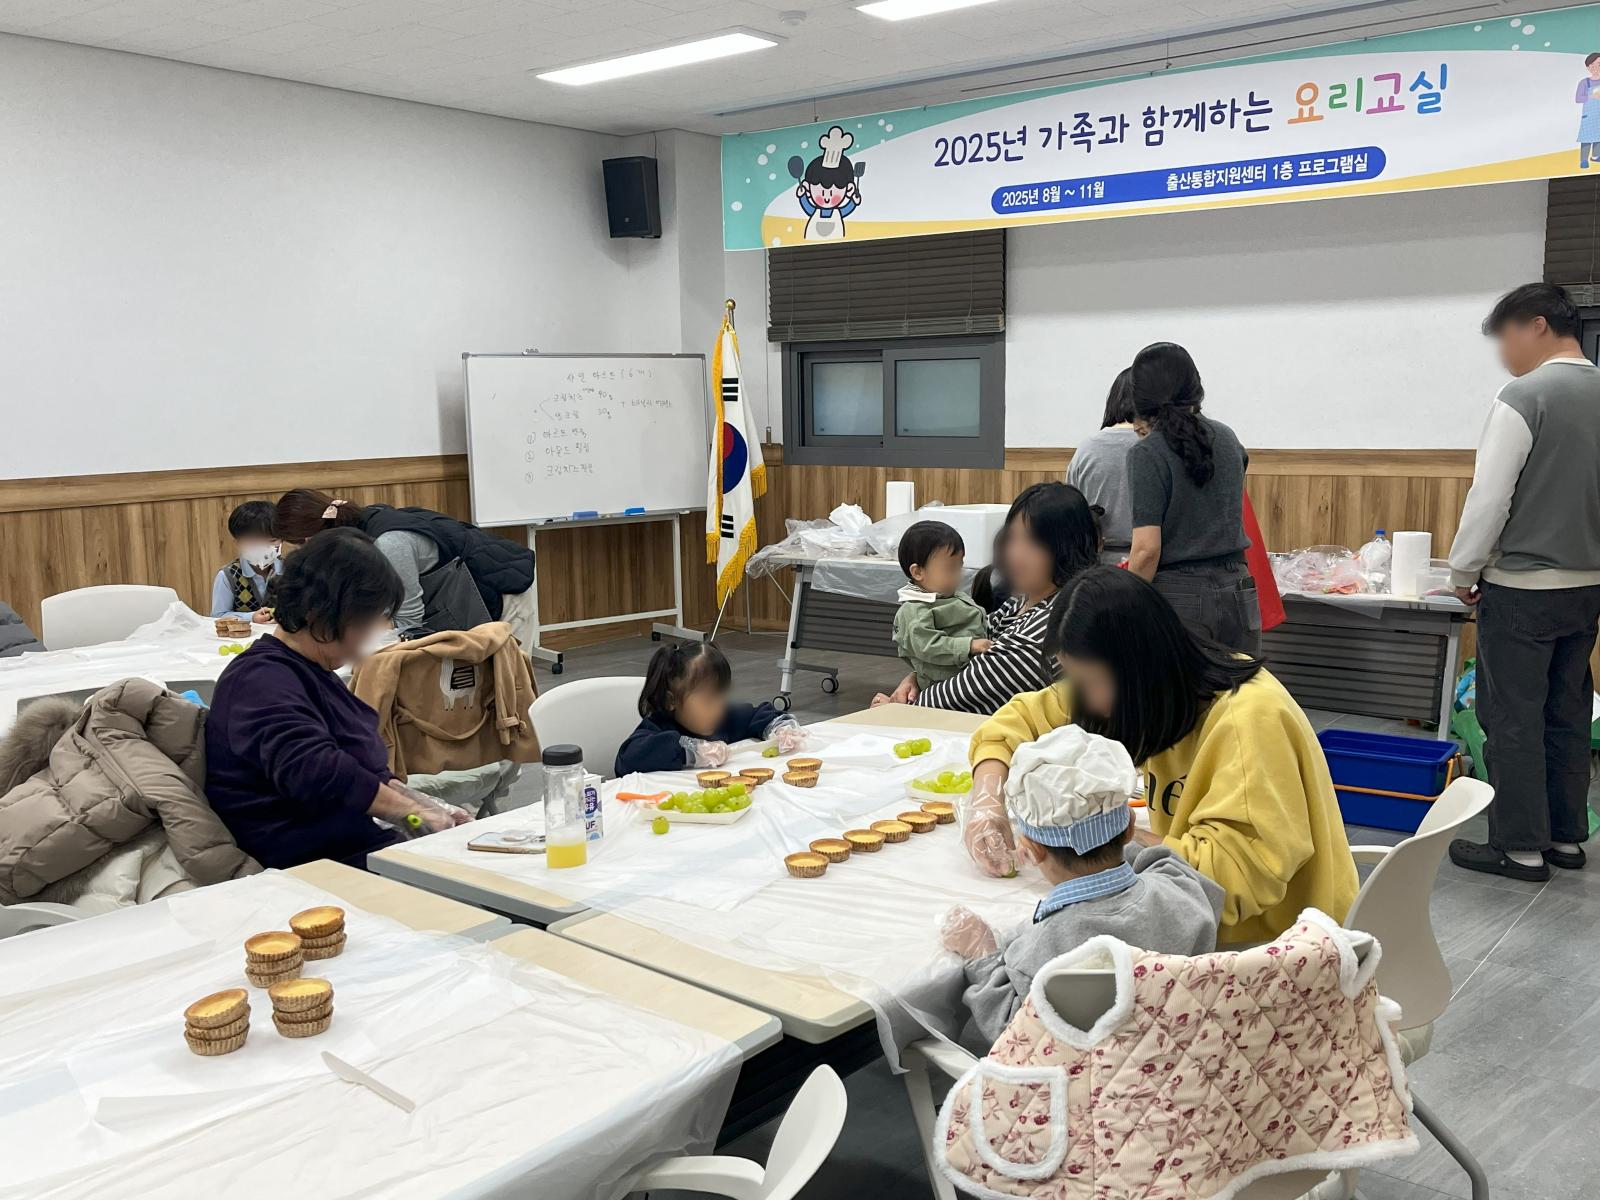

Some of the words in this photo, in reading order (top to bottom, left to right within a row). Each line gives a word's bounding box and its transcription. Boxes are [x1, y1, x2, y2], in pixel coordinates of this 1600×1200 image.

[934, 125, 1027, 167] 2025년
[1038, 112, 1130, 153] 가족과
[1142, 91, 1273, 147] 함께하는
[1287, 63, 1448, 124] 요리교실
[1166, 163, 1267, 191] 출산통합지원센터
[1273, 160, 1293, 181] 1층
[1298, 152, 1368, 177] 프로그램실
[1002, 188, 1039, 207] 2025년
[1042, 185, 1061, 203] 8월
[1079, 181, 1105, 199] 11월
